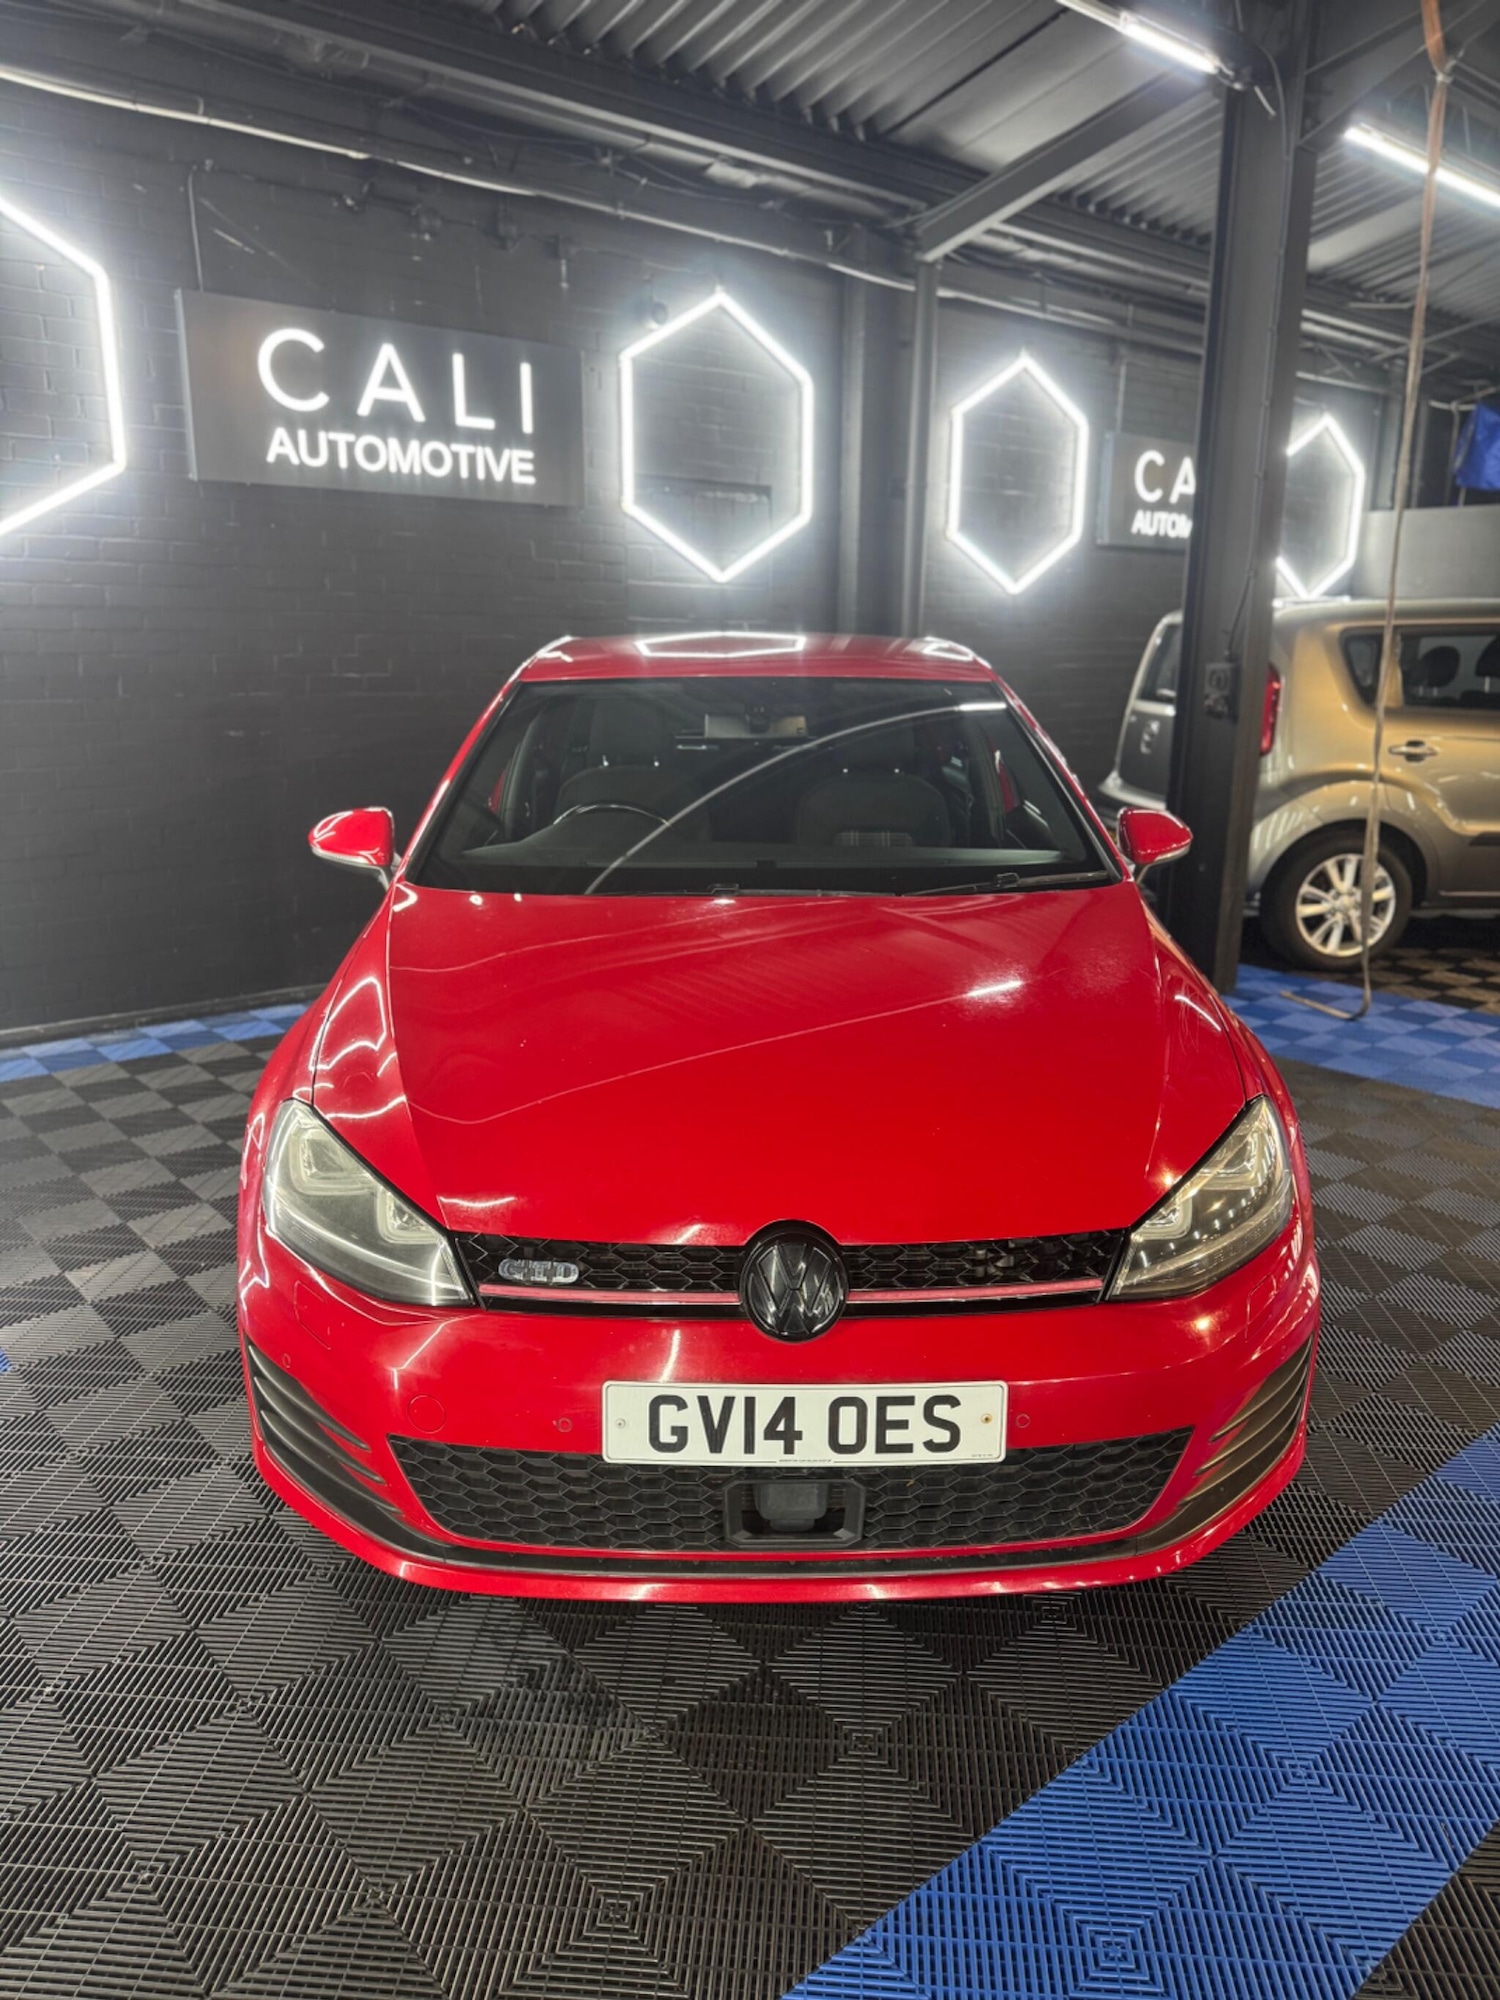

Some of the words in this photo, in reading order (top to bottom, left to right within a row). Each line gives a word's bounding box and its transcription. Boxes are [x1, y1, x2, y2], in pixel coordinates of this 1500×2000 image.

[257, 327, 534, 434] CALI
[266, 426, 536, 485] AUTOMOTIVE
[498, 1258, 579, 1284] GTD
[648, 1394, 803, 1455] GV14
[828, 1394, 962, 1455] OES
